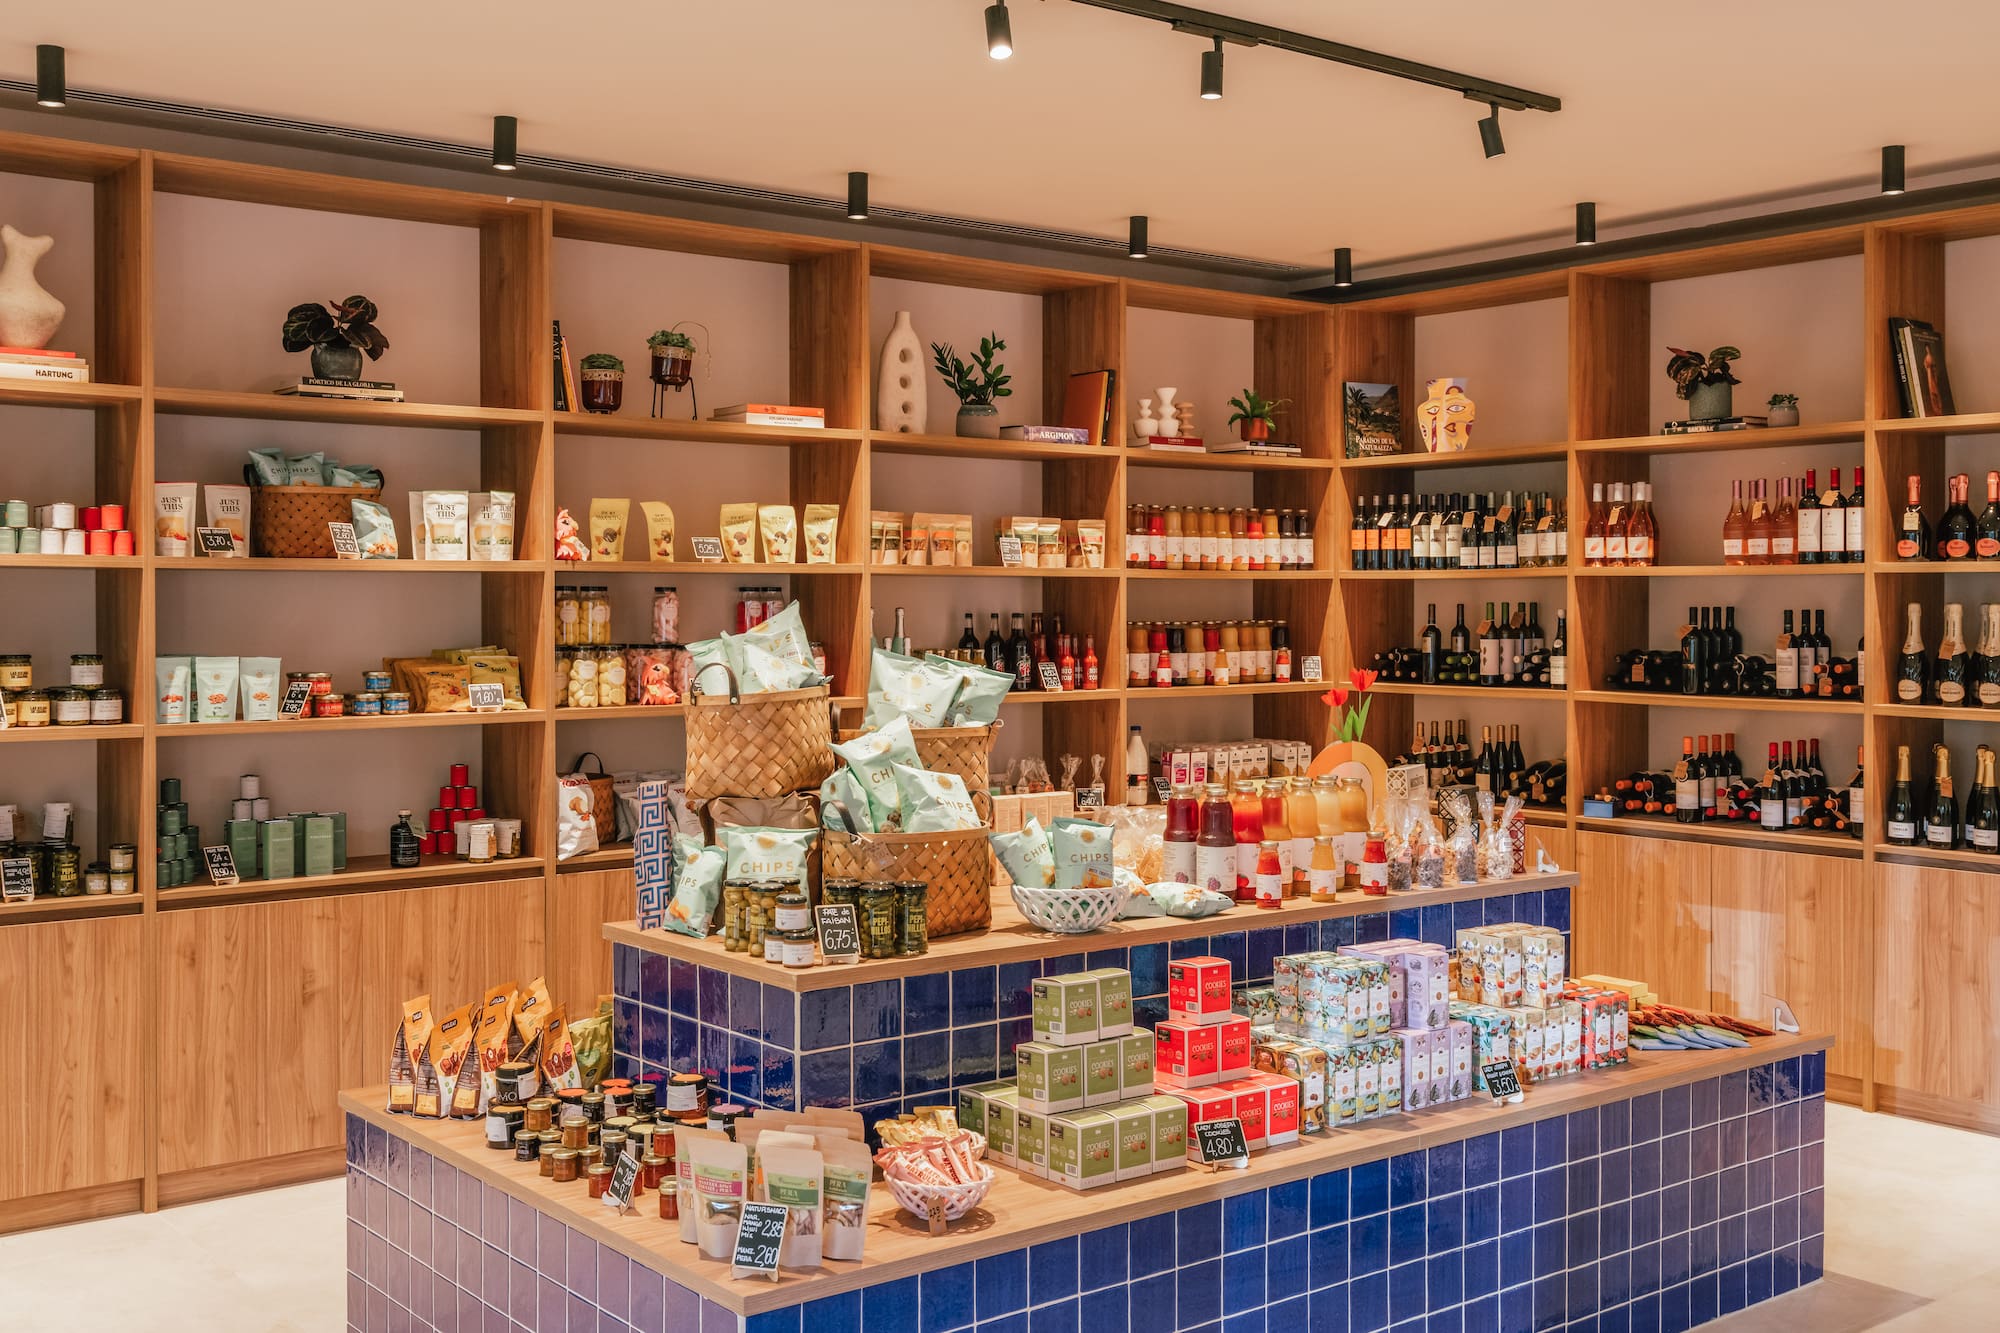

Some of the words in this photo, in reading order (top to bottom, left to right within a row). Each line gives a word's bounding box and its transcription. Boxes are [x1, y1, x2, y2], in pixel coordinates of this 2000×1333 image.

[35, 369, 73, 379] HARTUNG
[1040, 431, 1074, 440] ARGIMON
[1359, 442, 1393, 451] NATURALEZA
[161, 496, 183, 504] JUST
[206, 535, 226, 546] 3,70
[871, 758, 914, 784] CHIS
[936, 796, 974, 813] CHIPS
[1023, 842, 1048, 863] CHIP
[1070, 853, 1110, 863] CHIPS
[740, 861, 795, 874] CHIPS
[680, 877, 697, 888] IPS
[1205, 980, 1226, 990] COOKIES
[1105, 992, 1127, 1002] COOKIES
[1069, 999, 1093, 1009] COOKIES
[1225, 1037, 1247, 1048] COOKIES
[1192, 1043, 1214, 1054] COOKIES
[1127, 1052, 1150, 1063] COOKIES
[1053, 1065, 1078, 1076] COOKIES
[1091, 1059, 1114, 1071] COOKIES
[1273, 1100, 1295, 1111] COOKIES
[1240, 1107, 1263, 1119] COOKIES
[1160, 1124, 1183, 1136] COOKIES
[1213, 1120, 1237, 1130] JOSEPH
[1123, 1132, 1147, 1143] COOKIES
[1204, 1128, 1232, 1137] COOKIES
[1086, 1141, 1111, 1153] COOKIES
[829, 1180, 847, 1188] PERA
[780, 1188, 798, 1197] PERA
[742, 1220, 763, 1228] MANGO
